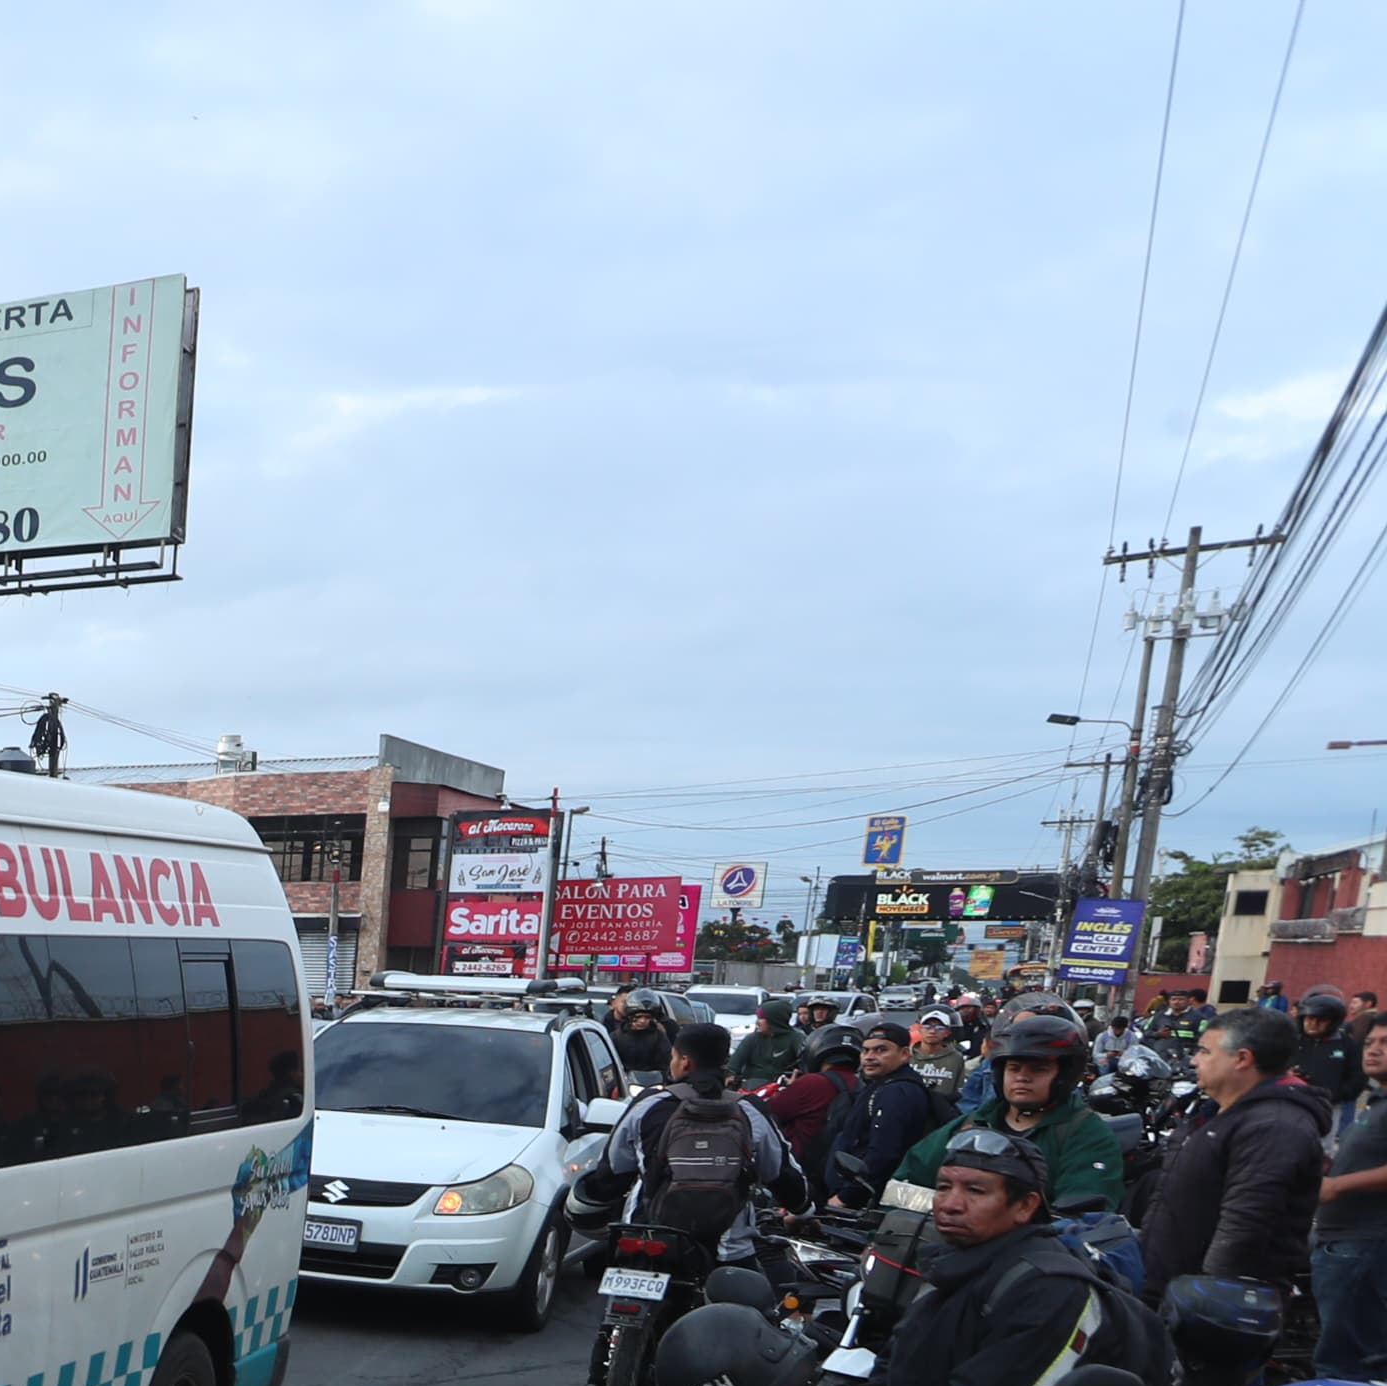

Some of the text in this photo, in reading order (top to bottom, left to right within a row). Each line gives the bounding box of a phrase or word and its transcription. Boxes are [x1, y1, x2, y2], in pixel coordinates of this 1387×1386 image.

[617, 882, 667, 899] PARA
[876, 893, 930, 905] BLACK
[560, 902, 655, 920] EVENTOS
[448, 906, 540, 936] Sarita
[1075, 920, 1134, 934] INGLÉS
[581, 930, 660, 942] 2442-8687
[1095, 935, 1123, 943] CALL
[1074, 944, 1119, 953] CENTER
[304, 1224, 357, 1244] 578DNP
